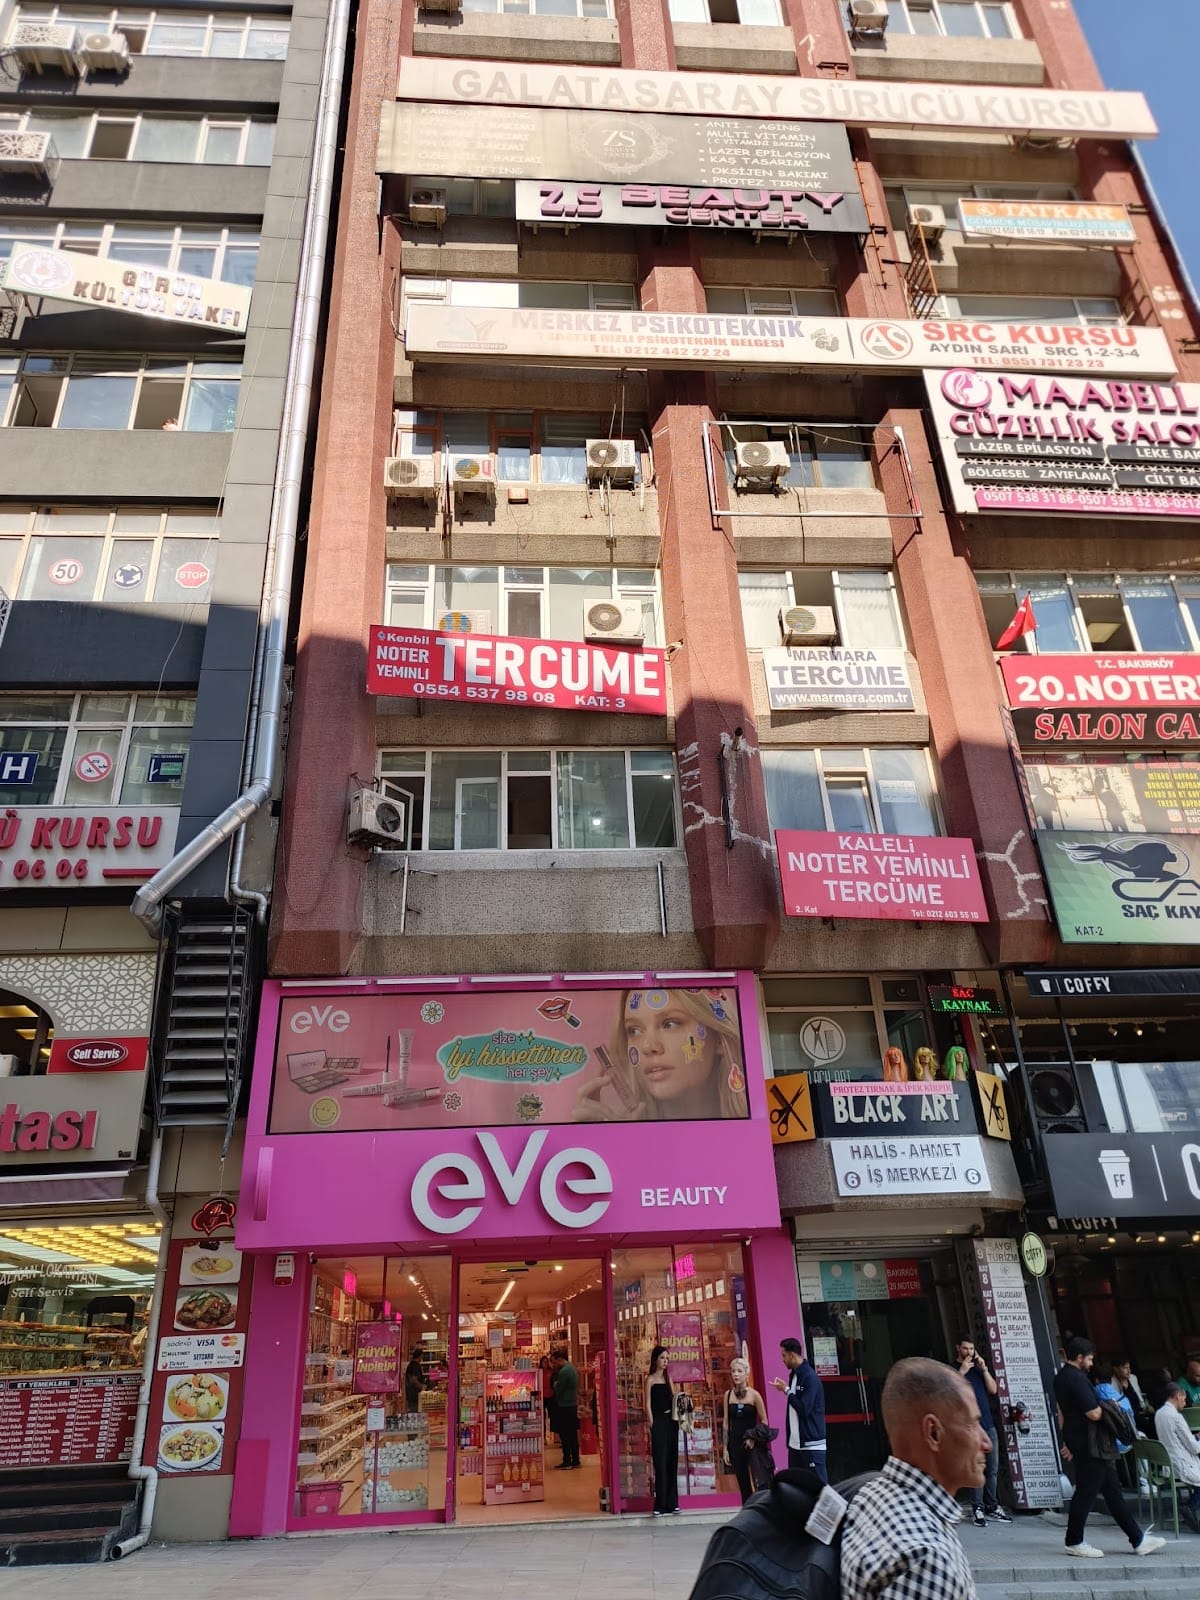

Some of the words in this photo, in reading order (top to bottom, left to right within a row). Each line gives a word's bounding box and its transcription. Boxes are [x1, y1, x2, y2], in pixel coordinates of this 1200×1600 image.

[452, 68, 783, 118] GALATASARAY
[800, 77, 948, 126] SÜRÜCÜ
[977, 86, 1110, 129] KURSU
[758, 124, 801, 132] AGING
[708, 147, 751, 156] LAZER
[710, 156, 737, 166] KAŞ
[741, 157, 812, 168] TASARIMI
[711, 177, 766, 187] PROTEZ
[768, 179, 824, 189] TIRNAK
[777, 170, 829, 180] BAKIMI
[619, 184, 845, 214] BEAUTY
[665, 207, 810, 229] CENTER
[1001, 203, 1114, 220] TATKAR
[173, 303, 242, 328] VAKFI
[511, 311, 622, 332] MERKEZ
[922, 321, 998, 343] SRC
[1008, 325, 1138, 347] KURSU
[593, 345, 621, 354] TEL:
[624, 345, 659, 355] 0212
[662, 347, 689, 356] 442
[692, 348, 711, 357] 22
[929, 343, 983, 354] AYDIN
[987, 345, 1029, 355] SARI
[1044, 346, 1080, 357] SRC
[1084, 347, 1141, 358] 1-2-3-4
[971, 356, 1000, 366] TEL:
[1065, 358, 1084, 368] 23
[997, 375, 1199, 415] MAABELL
[949, 407, 1104, 443] GÜZELLİK
[1110, 417, 1200, 448] SALO
[969, 441, 1012, 451] LAZER
[1016, 441, 1094, 456] EPİLASYON
[1135, 448, 1171, 459] LEKE
[967, 467, 1030, 479] BÖLGESEL
[1039, 469, 1111, 481] ZAYIFLAMA
[1144, 472, 1176, 485] CİLT
[55, 563, 78, 580] 50
[178, 569, 207, 580] STOP
[376, 644, 430, 664] NOTER
[793, 650, 877, 662] MARMARA
[435, 636, 661, 697] TERCÜME
[1094, 659, 1117, 669] T.C.
[1118, 657, 1175, 670] BAKIRKÖY
[772, 661, 906, 686] TERCÜME
[412, 682, 460, 697] 0554
[466, 687, 498, 699] 537
[505, 689, 528, 701] 98
[532, 691, 556, 704] 08
[573, 694, 609, 708] KAT:
[614, 697, 626, 709] 3
[1015, 674, 1200, 702] 20.NOTER
[775, 692, 908, 705] www.marmara.com.tr
[1034, 712, 1147, 741] SALON
[1156, 712, 1200, 741] CA
[2, 756, 33, 780] H
[30, 816, 163, 850] KURSU
[786, 851, 870, 875] NOTER
[874, 853, 971, 880] YEMİNLİ
[822, 876, 946, 906] TERCÜME
[1120, 903, 1160, 921] SAÇ
[1063, 976, 1112, 994] COFFY
[941, 999, 992, 1013] KAYNAK
[289, 1003, 351, 1034] eve
[492, 1032, 517, 1045] size
[73, 1049, 92, 1061] Self
[92, 1048, 121, 1061] Servis
[476, 1043, 586, 1068] hissettiren
[506, 1065, 528, 1080] her
[530, 1068, 552, 1082] şey
[833, 1085, 864, 1095] PROTEZ
[832, 1094, 907, 1125] BLACK
[920, 1094, 960, 1123] ART
[849, 1141, 899, 1160] HALİS
[907, 1142, 962, 1159] AHMET
[410, 1128, 615, 1235] eve
[865, 1163, 884, 1188] İŞ
[886, 1162, 958, 1183] MERKEZİ
[1113, 1172, 1127, 1188] FF
[639, 1185, 729, 1209] BEAUTY
[976, 1249, 984, 1260] 9
[1024, 1246, 1043, 1261] COFFY
[982, 1273, 989, 1284] 8
[10, 1287, 36, 1299] Self
[37, 1286, 75, 1298] Servis
[986, 1299, 993, 1311] 7
[1000, 1314, 1028, 1322] TATKAR
[989, 1327, 996, 1339] 6
[196, 1338, 216, 1348] VISA
[660, 1336, 699, 1348] BÜYÜK
[357, 1345, 397, 1359] BÜYÜK
[994, 1351, 1001, 1363] 5
[999, 1378, 1006, 1390] 4
[1002, 1404, 1010, 1418] 3
[1007, 1433, 1015, 1446] 2
[1012, 1461, 1019, 1475] 1
[1026, 1480, 1037, 1490] ÇAY
